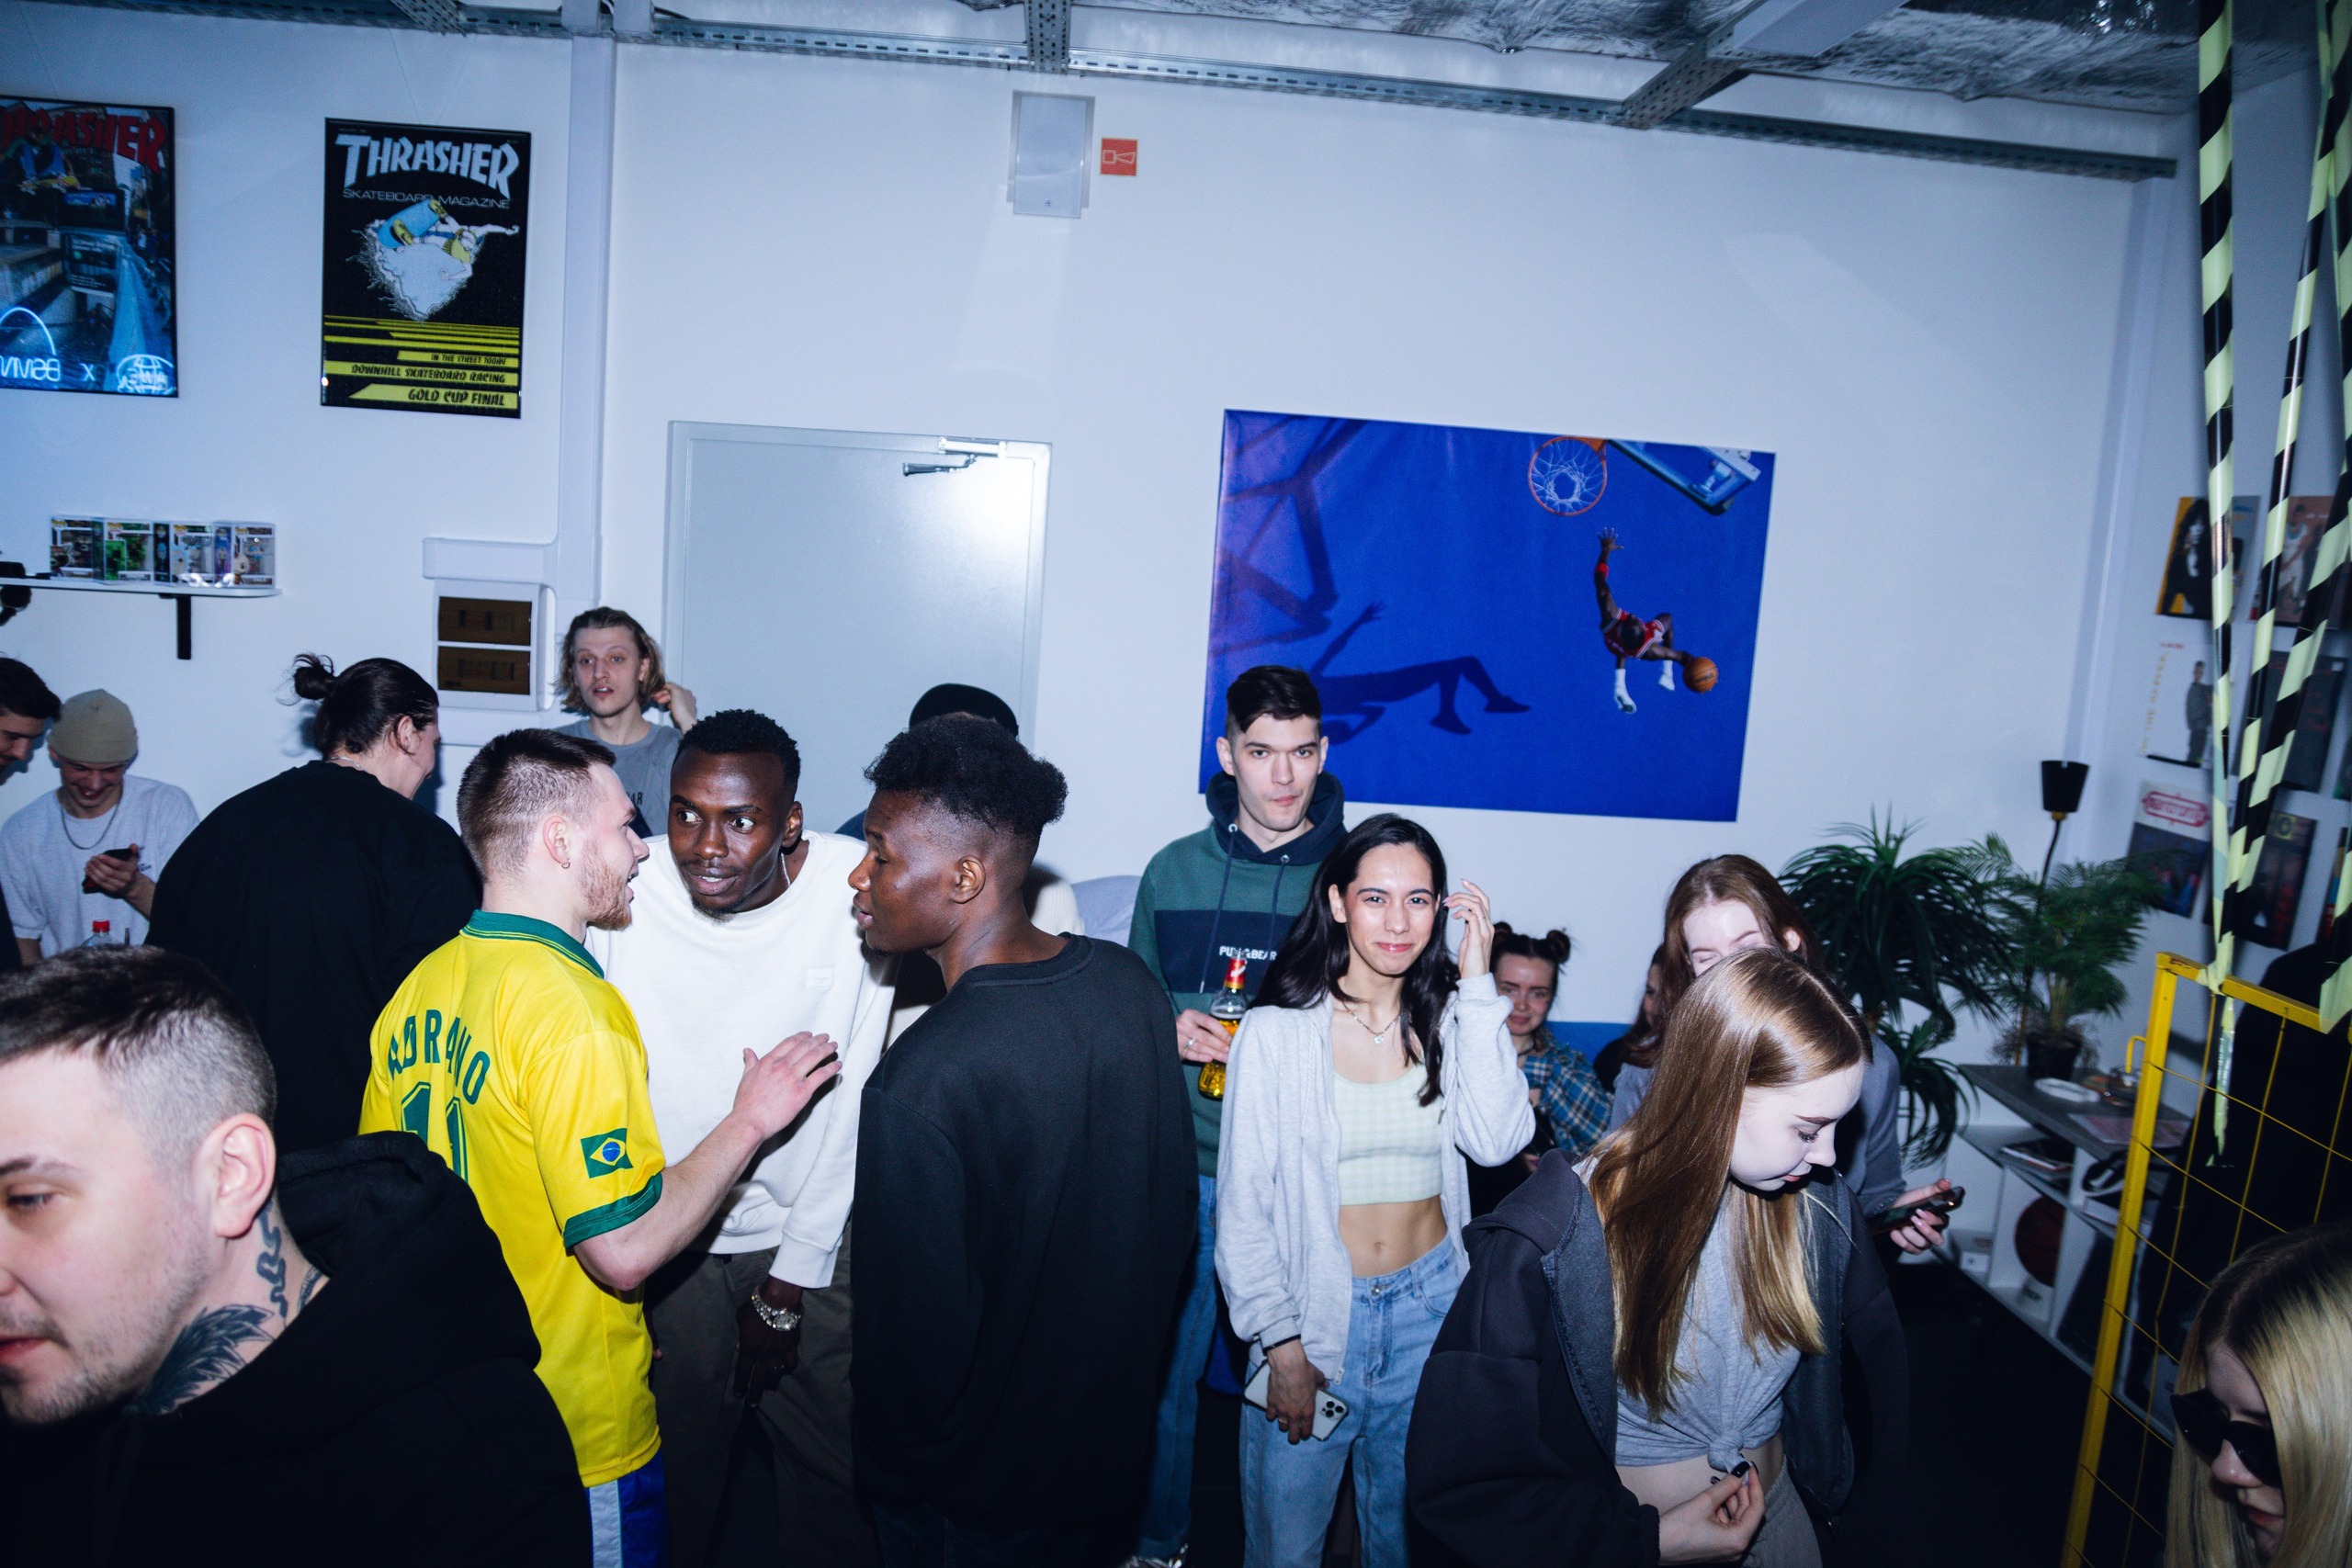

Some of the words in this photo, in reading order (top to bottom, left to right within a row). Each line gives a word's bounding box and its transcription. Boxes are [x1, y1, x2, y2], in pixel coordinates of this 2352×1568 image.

[0, 106, 166, 175] HRASHER
[334, 133, 520, 199] THRASHER
[343, 188, 434, 203] SKATEBOARD
[438, 195, 510, 210] MAGAZINE
[457, 355, 482, 364] STREET
[484, 356, 506, 366] TODAY
[351, 364, 401, 377] DOWNHILL
[405, 367, 467, 380] SKATEBOARD
[469, 371, 505, 383] RACING
[408, 389, 439, 401] GOLD
[443, 390, 469, 402] CUP
[471, 392, 504, 406] FINAL
